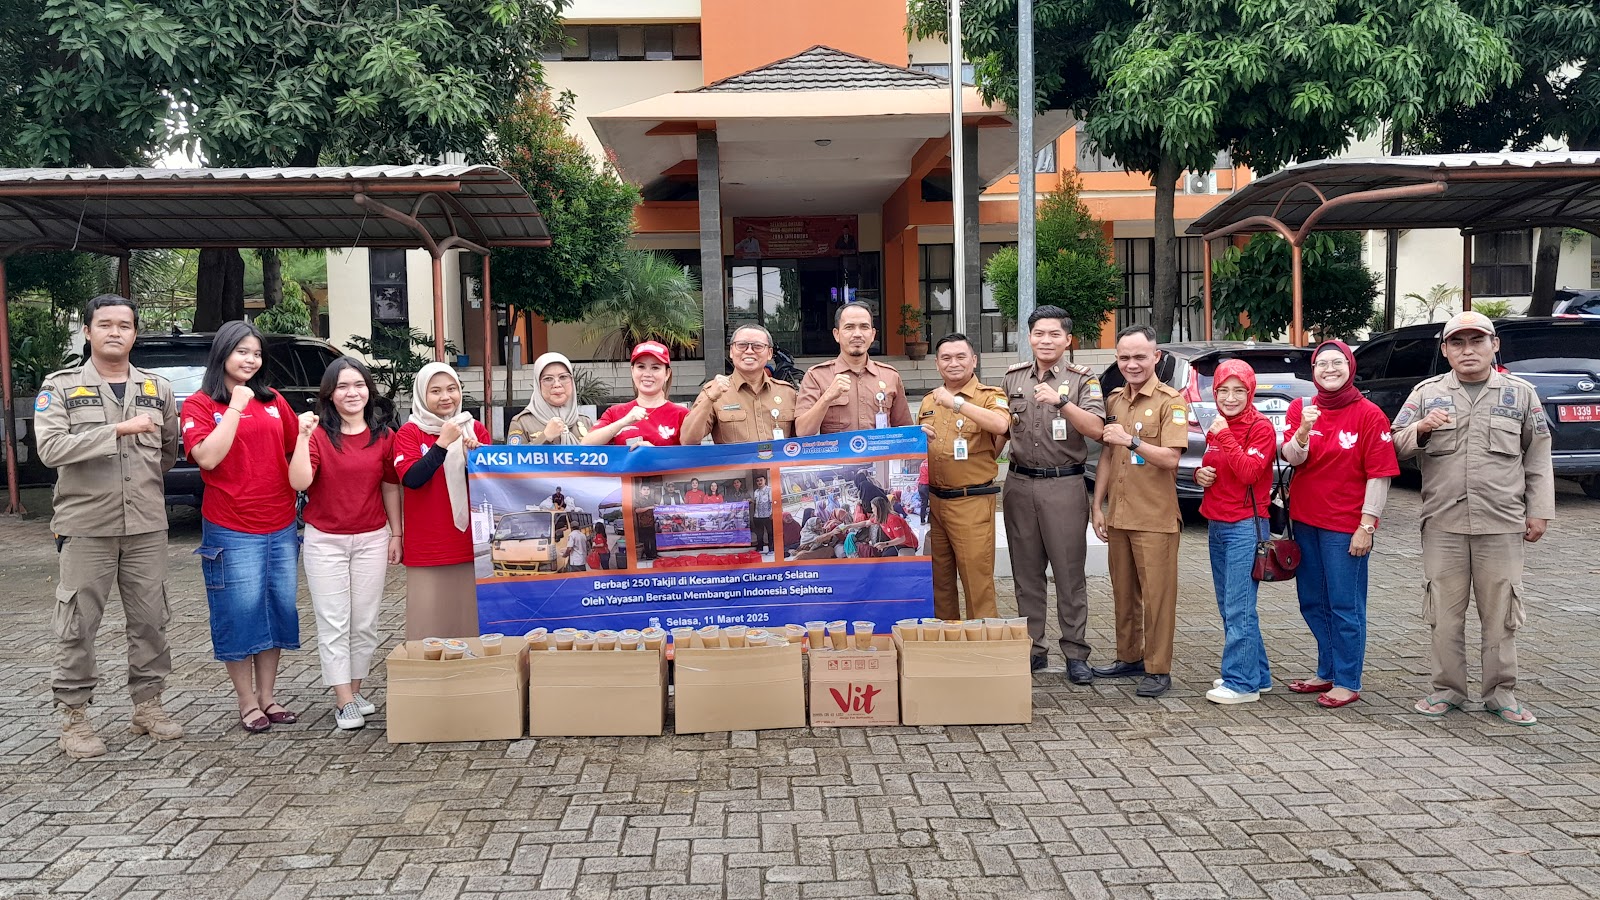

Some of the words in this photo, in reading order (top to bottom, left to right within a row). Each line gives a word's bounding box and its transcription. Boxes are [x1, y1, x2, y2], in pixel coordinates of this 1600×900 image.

[1560, 406, 1567, 417] B
[1572, 406, 1592, 416] 1339
[475, 452, 513, 466] AKSI
[517, 452, 549, 465] MBI
[553, 452, 608, 466] KE-220
[593, 580, 630, 590] Berbagi
[632, 580, 650, 588] 250
[651, 577, 676, 588] Takjil
[678, 577, 687, 586] di
[689, 575, 740, 585] Kecamatan
[742, 573, 783, 582] Cikarang
[785, 570, 819, 579] Selatan
[581, 597, 605, 607] Oleh
[606, 594, 644, 606] Yayasan
[645, 592, 682, 602] Bersatu
[683, 590, 741, 600] Membangun
[743, 586, 788, 597] Indonesia
[789, 584, 833, 596] Sejahtera
[666, 617, 701, 627] Selasa,
[704, 615, 714, 624] 11
[717, 614, 745, 624] Maret
[746, 613, 769, 622] 2025
[829, 682, 882, 714] Vit
